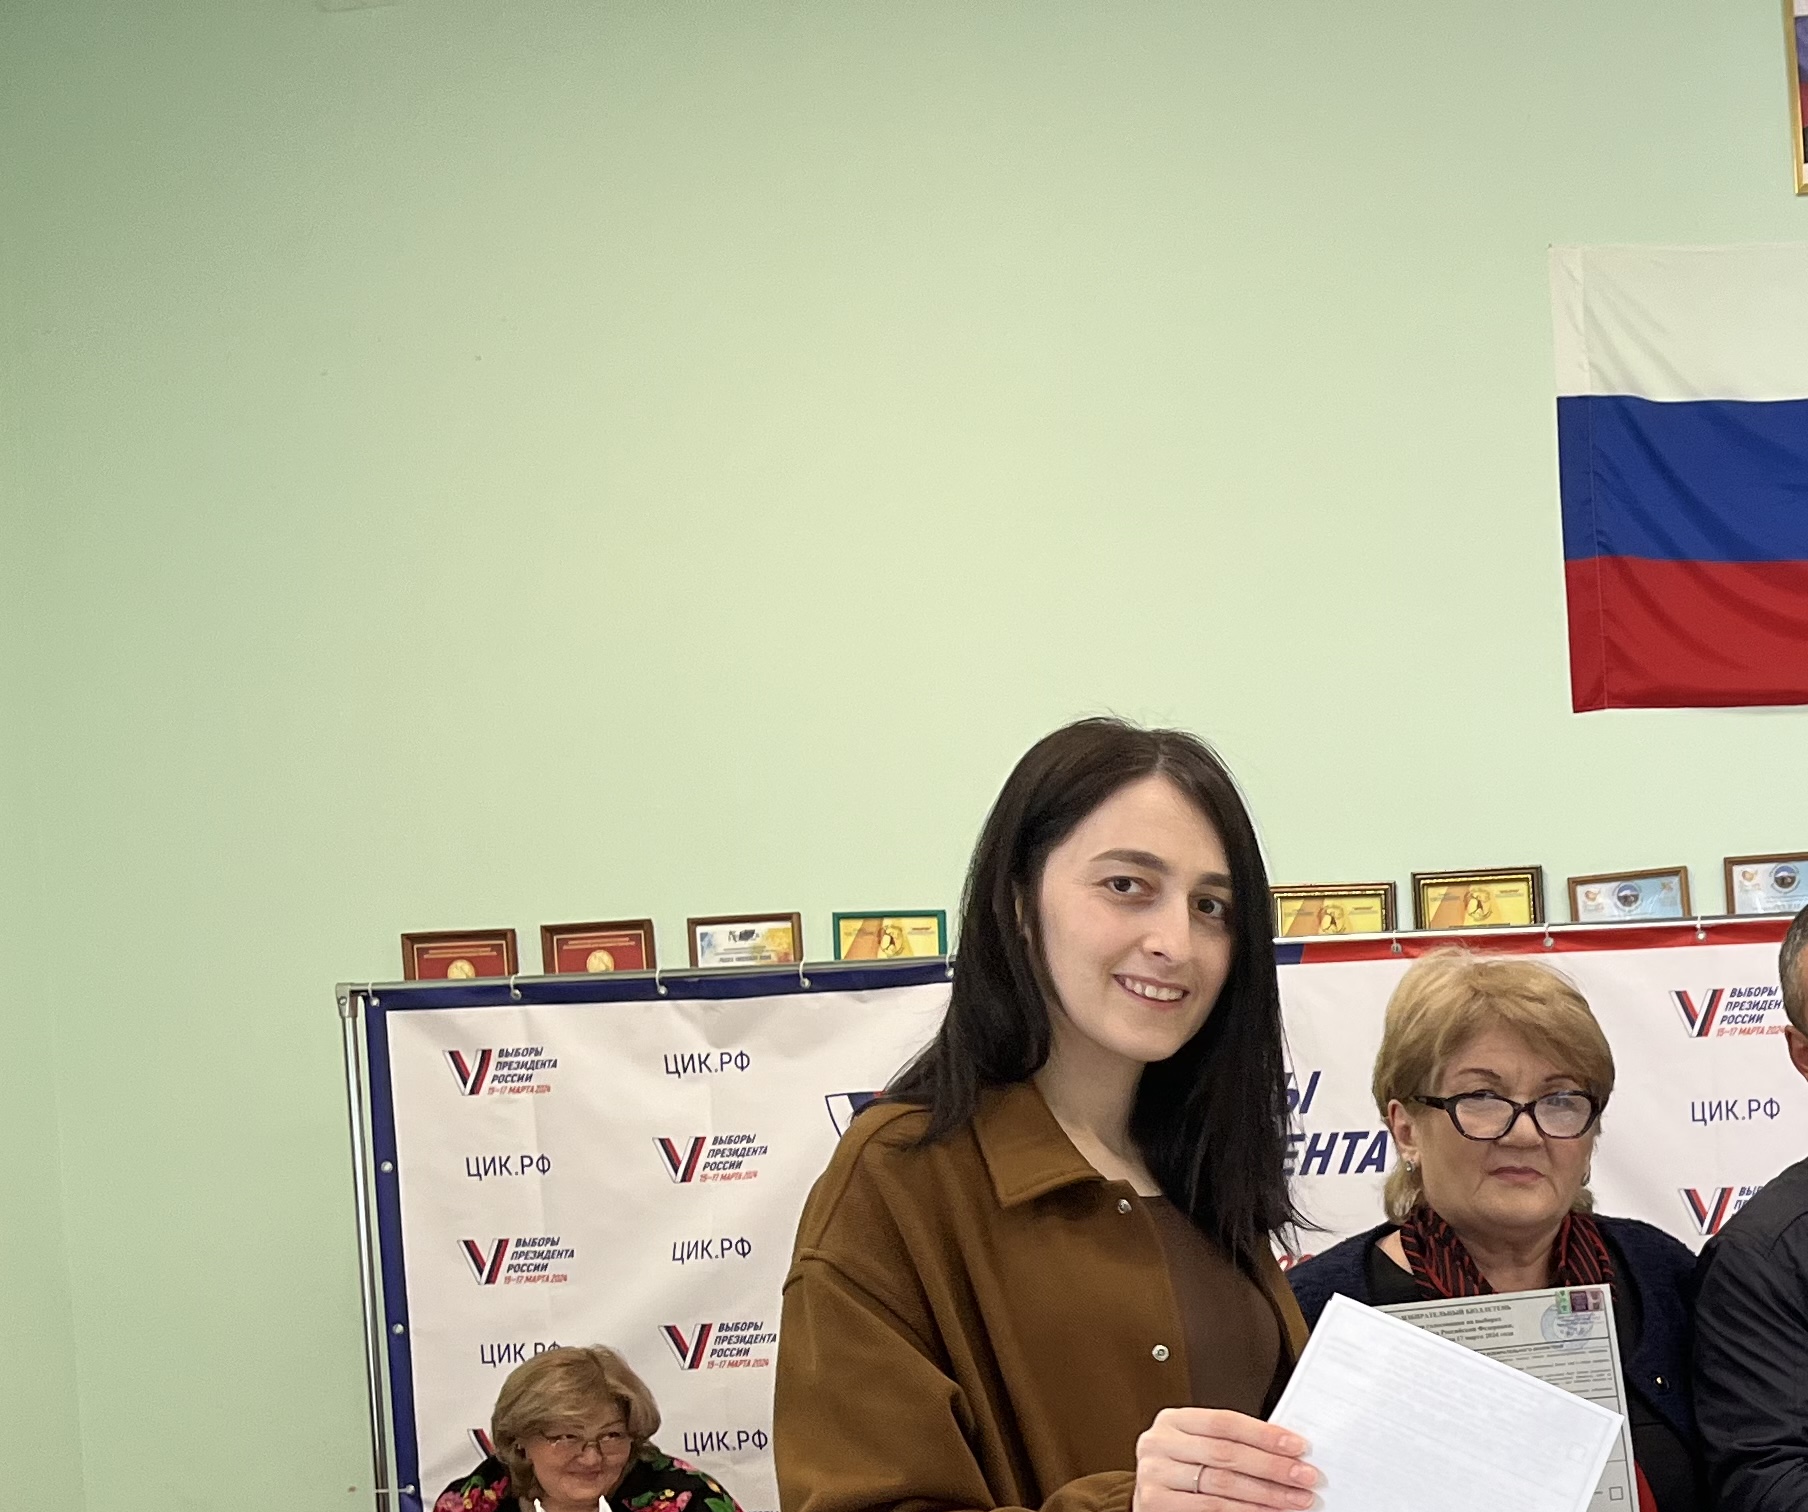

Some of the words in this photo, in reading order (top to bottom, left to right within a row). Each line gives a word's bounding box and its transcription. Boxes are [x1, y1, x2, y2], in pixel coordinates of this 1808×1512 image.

[1729, 986, 1779, 998] ВЫБОРЫ
[1725, 1000, 1785, 1012] ПРЕЗИДЕН
[1719, 1013, 1764, 1025] РОССИИ
[1738, 1026, 1764, 1036] МАРТА
[498, 1046, 544, 1058] ВЫБОРЫ
[495, 1059, 558, 1071] ПРЕЗИДЕНТА
[664, 1050, 750, 1079] ЦИК.РФ
[491, 1073, 533, 1084] РОССИИ
[508, 1085, 534, 1094] МАРТА
[1691, 1097, 1780, 1126] ЦИК.РФ
[712, 1134, 756, 1146] ВЫБОРЫ
[707, 1145, 768, 1158] ПРЕЗИДЕНТА
[466, 1153, 551, 1181] ЦИК.РФ
[702, 1160, 743, 1172] РОССИИ
[720, 1172, 742, 1181] МАРТА
[515, 1236, 560, 1248] ВЫБОРЫ
[510, 1249, 575, 1261] ПРЕЗИДЕНТА
[672, 1236, 751, 1265] ЦИК.РФ
[506, 1262, 549, 1273] РОССИИ
[524, 1275, 549, 1284] МАРТА
[718, 1321, 764, 1332] ВЫБОРЫ
[714, 1333, 777, 1345] ПРЕЗИДЕНТА
[710, 1347, 750, 1358] РОССИИ
[727, 1359, 751, 1368] МАРТА
[684, 1429, 768, 1456] ЦИК.РФ
